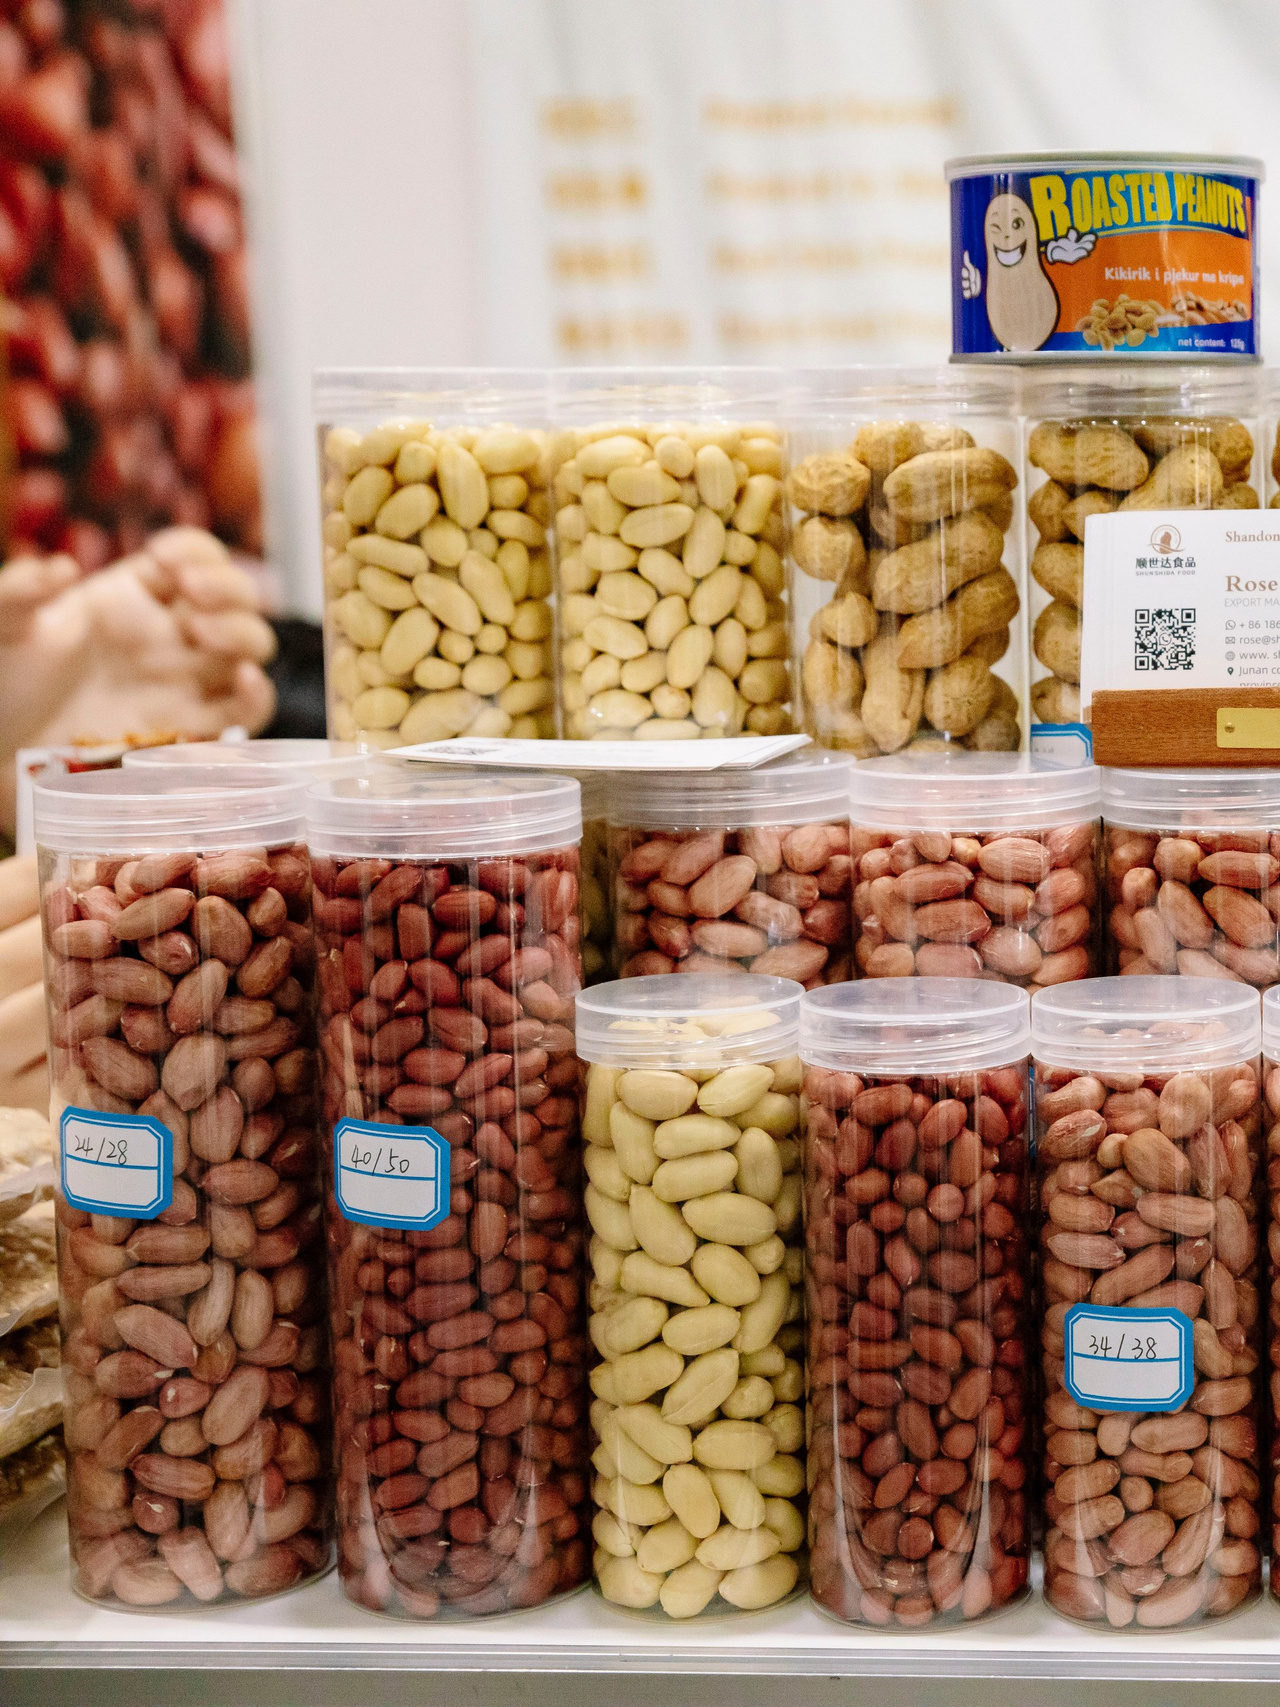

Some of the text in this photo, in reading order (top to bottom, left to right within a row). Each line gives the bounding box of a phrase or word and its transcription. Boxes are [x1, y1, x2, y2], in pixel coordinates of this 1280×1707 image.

[1029, 172, 1246, 241] ROASTED PEANUTS
[1104, 266, 1151, 281] Kikirik
[1155, 267, 1160, 281] i
[1135, 556, 1197, 569] 顺世达食品
[1225, 575, 1279, 592] Rose
[1224, 598, 1262, 607] EXPORT
[1248, 620, 1261, 629] 86
[1238, 666, 1268, 677] Junan
[73, 1134, 129, 1166] 24/28
[350, 1144, 411, 1178] 40/50
[1088, 1333, 1158, 1361] 34/38
